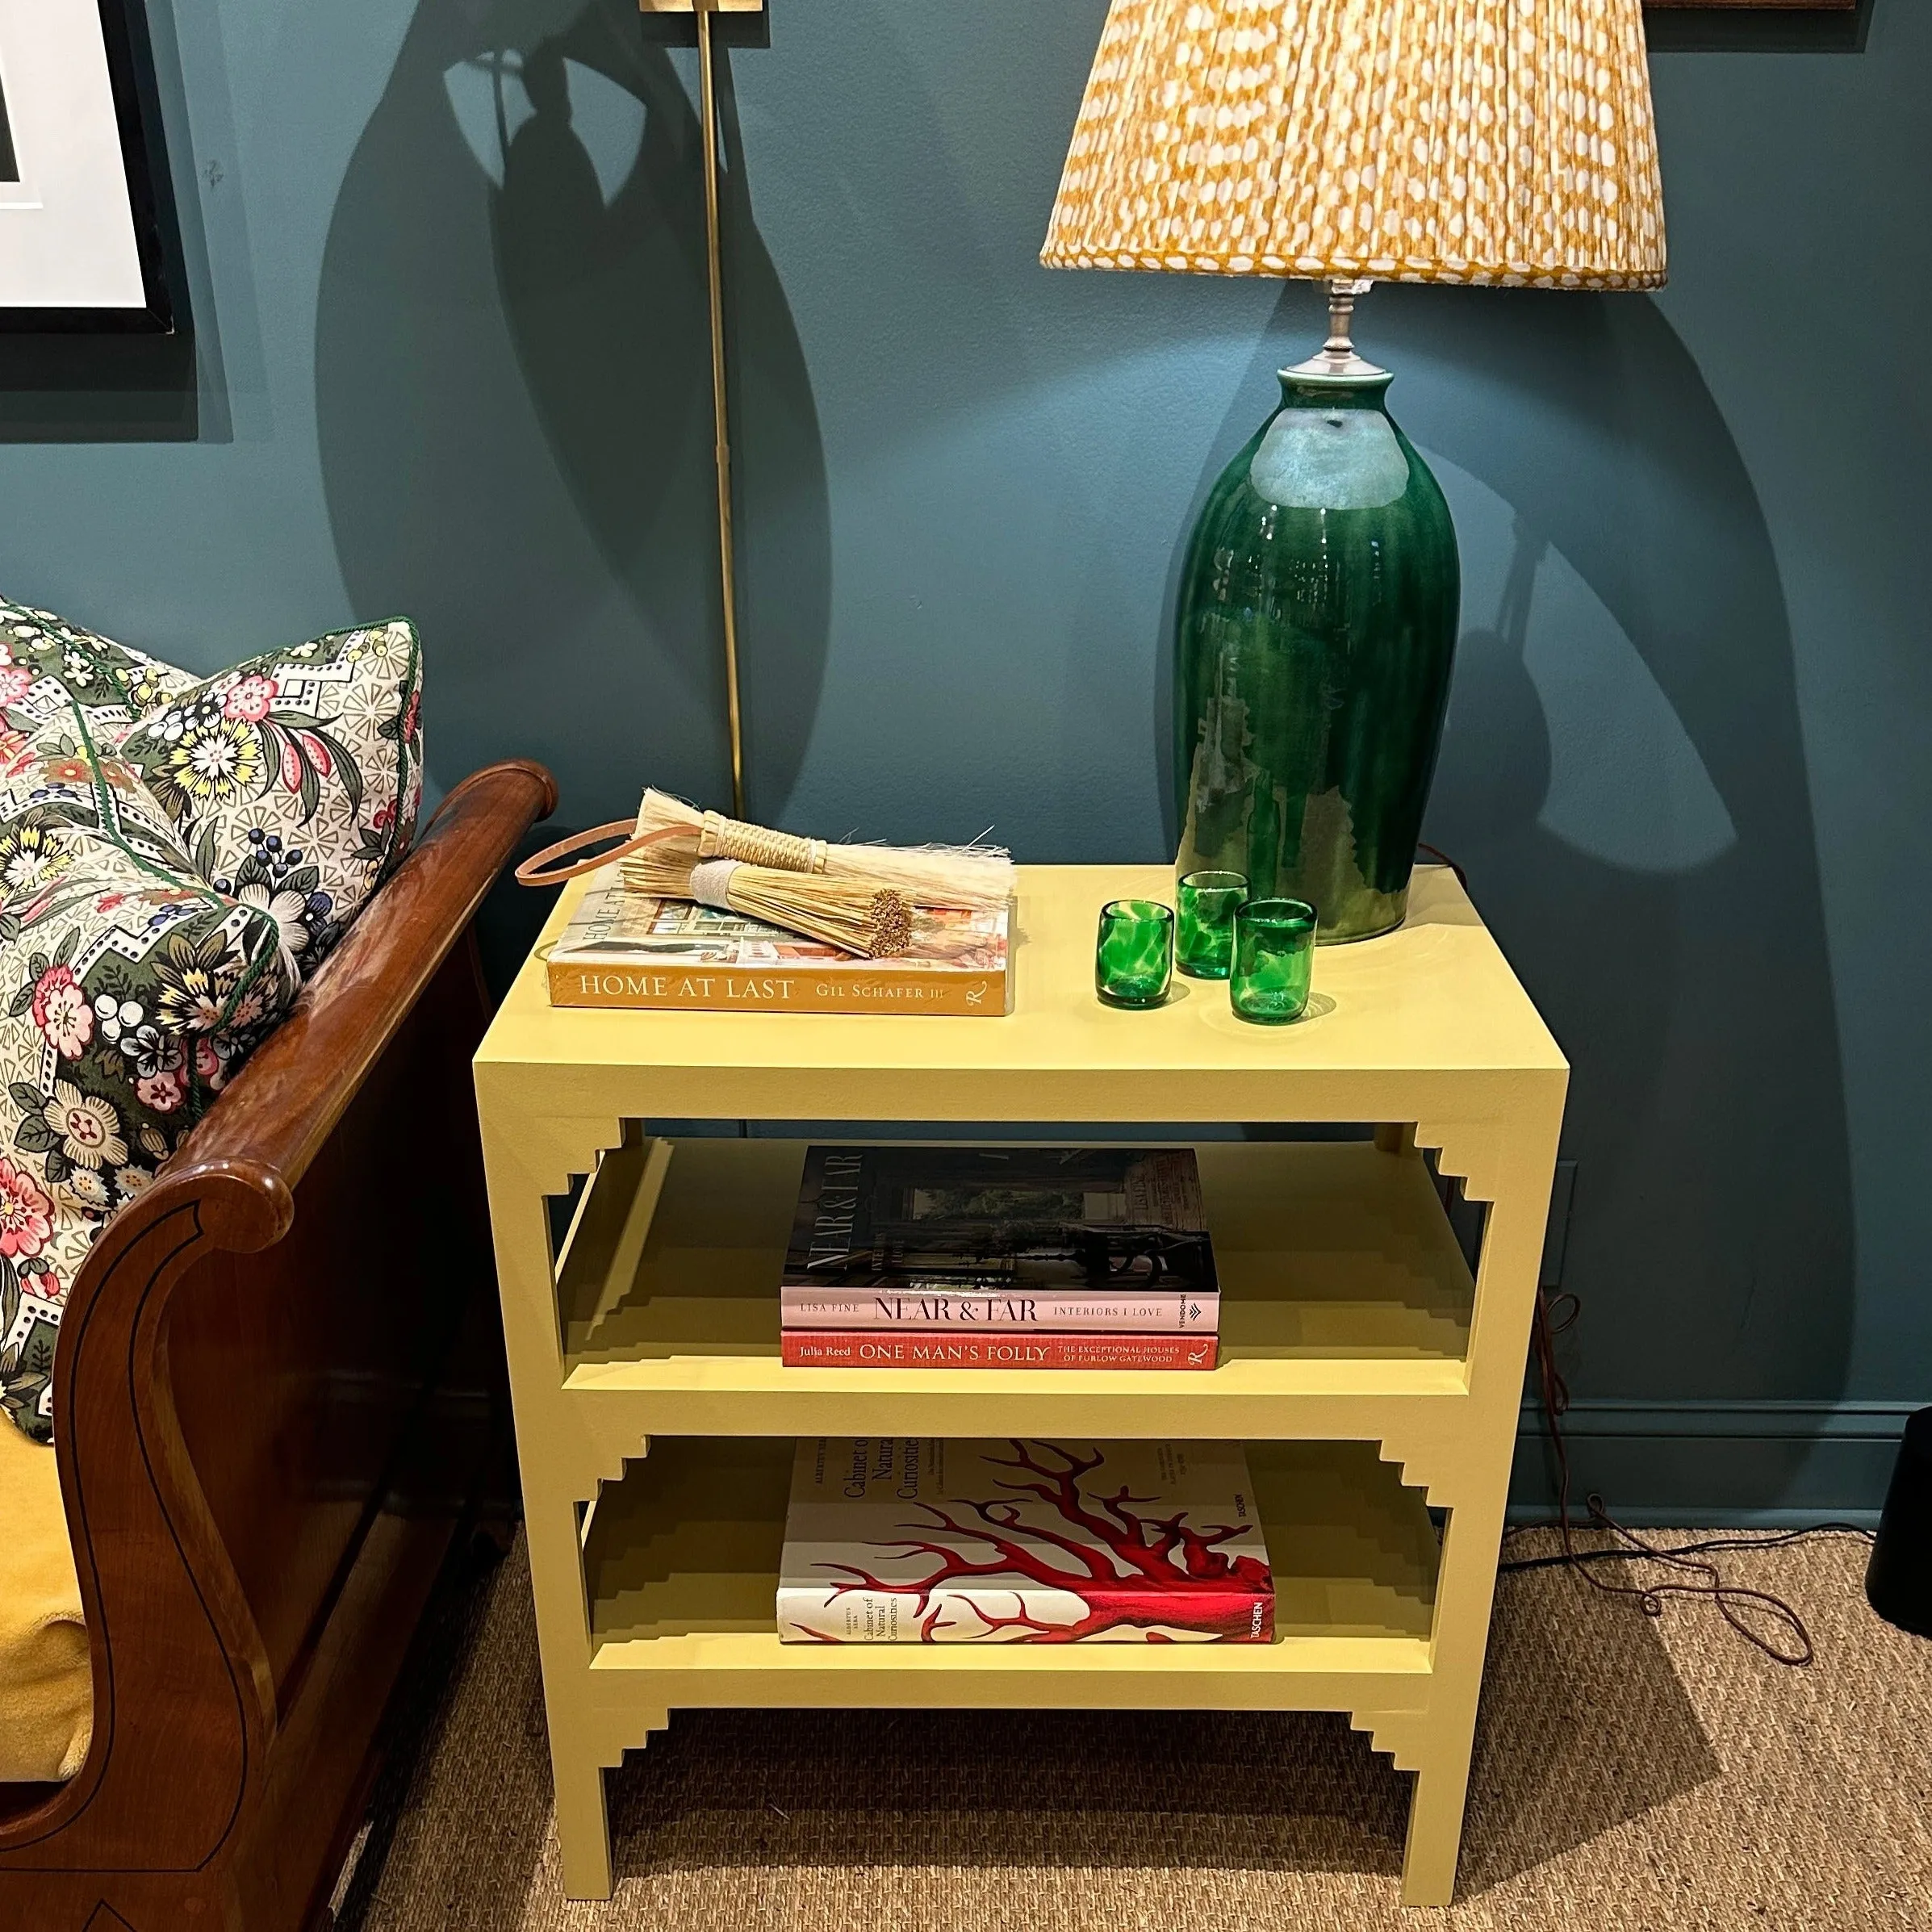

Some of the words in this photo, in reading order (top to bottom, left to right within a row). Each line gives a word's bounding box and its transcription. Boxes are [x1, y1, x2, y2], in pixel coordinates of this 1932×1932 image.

[580, 975, 667, 997] HOME
[678, 977, 716, 997] AT
[726, 979, 795, 999] LAST
[822, 1154, 864, 1190] FAR
[823, 1195, 858, 1209] &
[807, 1214, 855, 1271] NEAR
[800, 1303, 826, 1312] LISA
[831, 1303, 859, 1312] FINE
[874, 1297, 951, 1321] NEAR
[959, 1300, 980, 1322] &
[986, 1298, 1039, 1322] FAR
[1053, 1307, 1119, 1316] INTERIORS
[1123, 1307, 1127, 1316] I
[1133, 1307, 1163, 1317] LOVE
[1178, 1294, 1186, 1328] VENDOME
[800, 1346, 823, 1357] Julia
[826, 1346, 851, 1357] Reed
[859, 1344, 905, 1360] ONE
[912, 1345, 979, 1361] MAN'S
[986, 1345, 1051, 1361] FOLLY
[1057, 1345, 1077, 1353] THE
[1078, 1345, 1141, 1354] EXCEPTIONAL
[1143, 1346, 1180, 1354] HOUSES
[1119, 1355, 1173, 1363] GATEWOOD
[872, 1439, 893, 1480] Natura
[897, 1439, 919, 1499] Curiositie
[843, 1449, 867, 1499] Cabinet
[863, 1596, 873, 1609] of
[864, 1610, 874, 1641] Cabinet
[875, 1605, 886, 1637] Natural
[888, 1597, 898, 1641] Curiosities
[1250, 1602, 1263, 1639] TASCHEN
